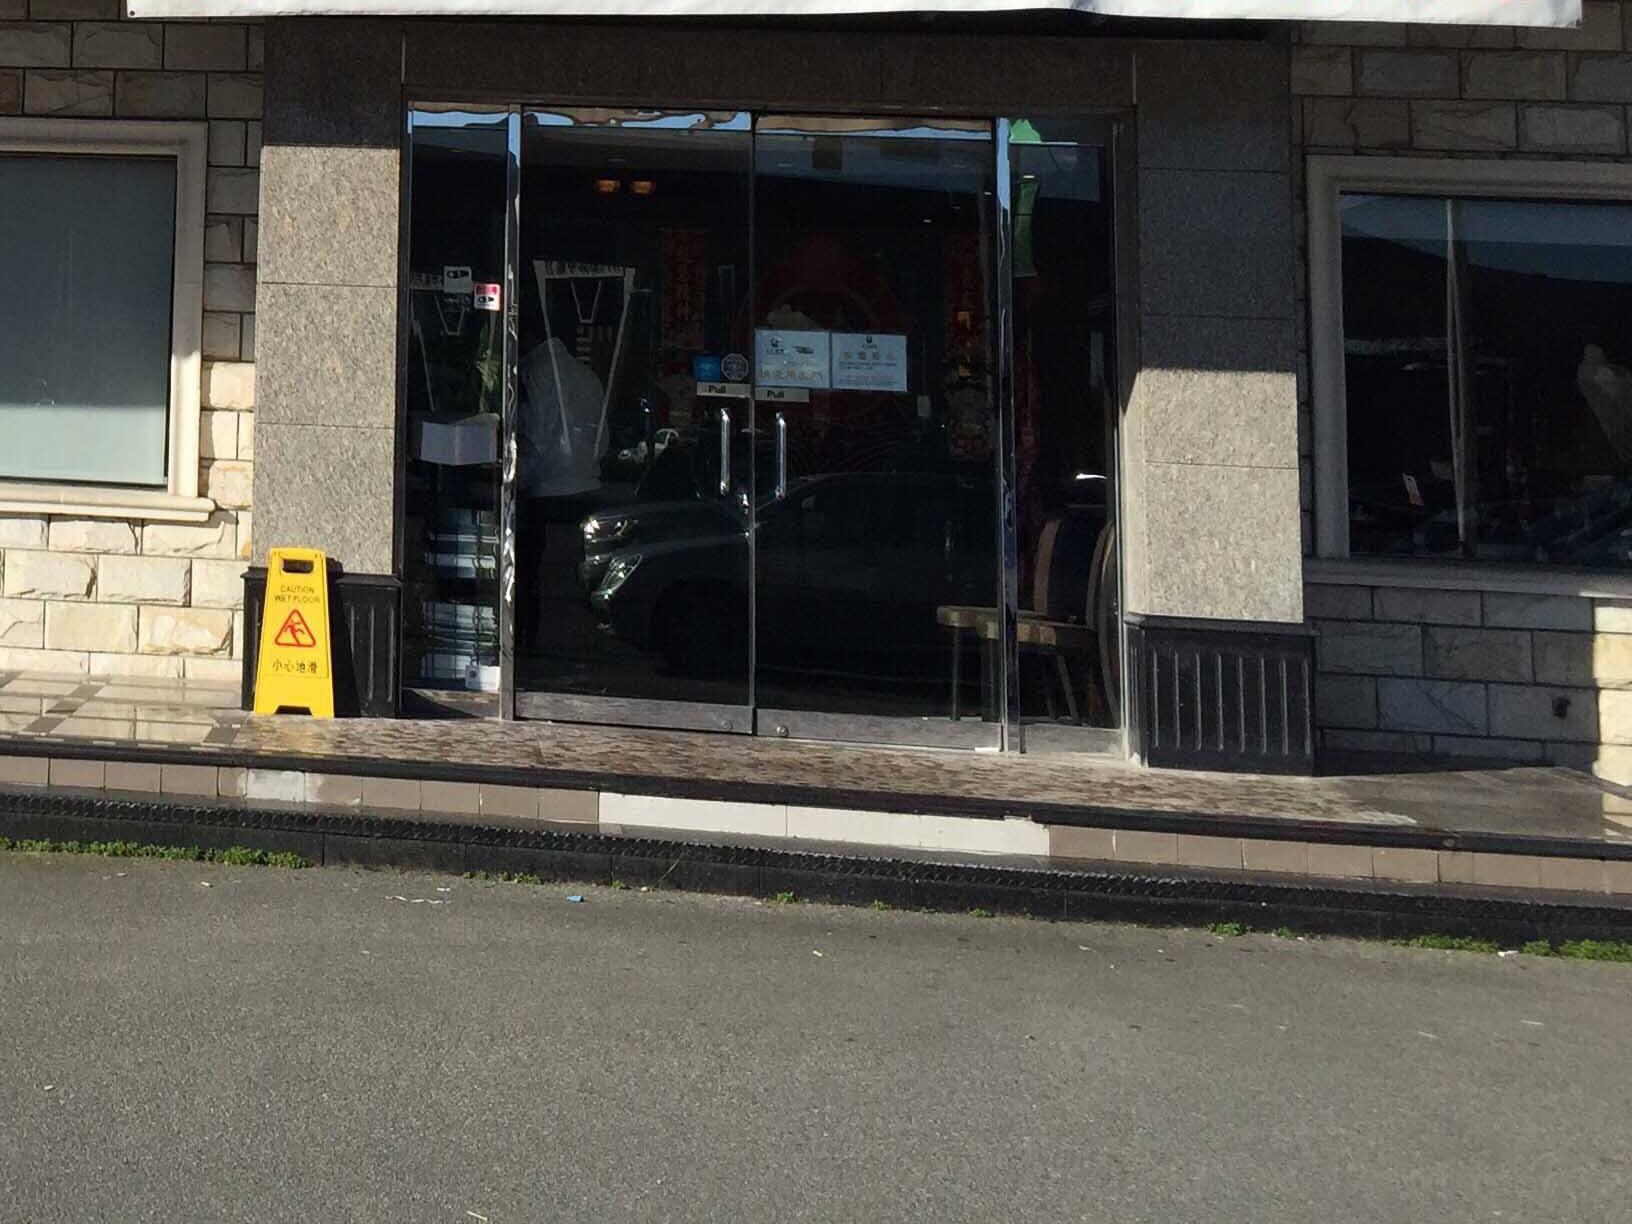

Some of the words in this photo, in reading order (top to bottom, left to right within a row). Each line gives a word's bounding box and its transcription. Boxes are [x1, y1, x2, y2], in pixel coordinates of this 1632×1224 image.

[708, 384, 727, 394] Pull
[767, 390, 785, 400] Pull
[280, 584, 315, 594] CAUTION
